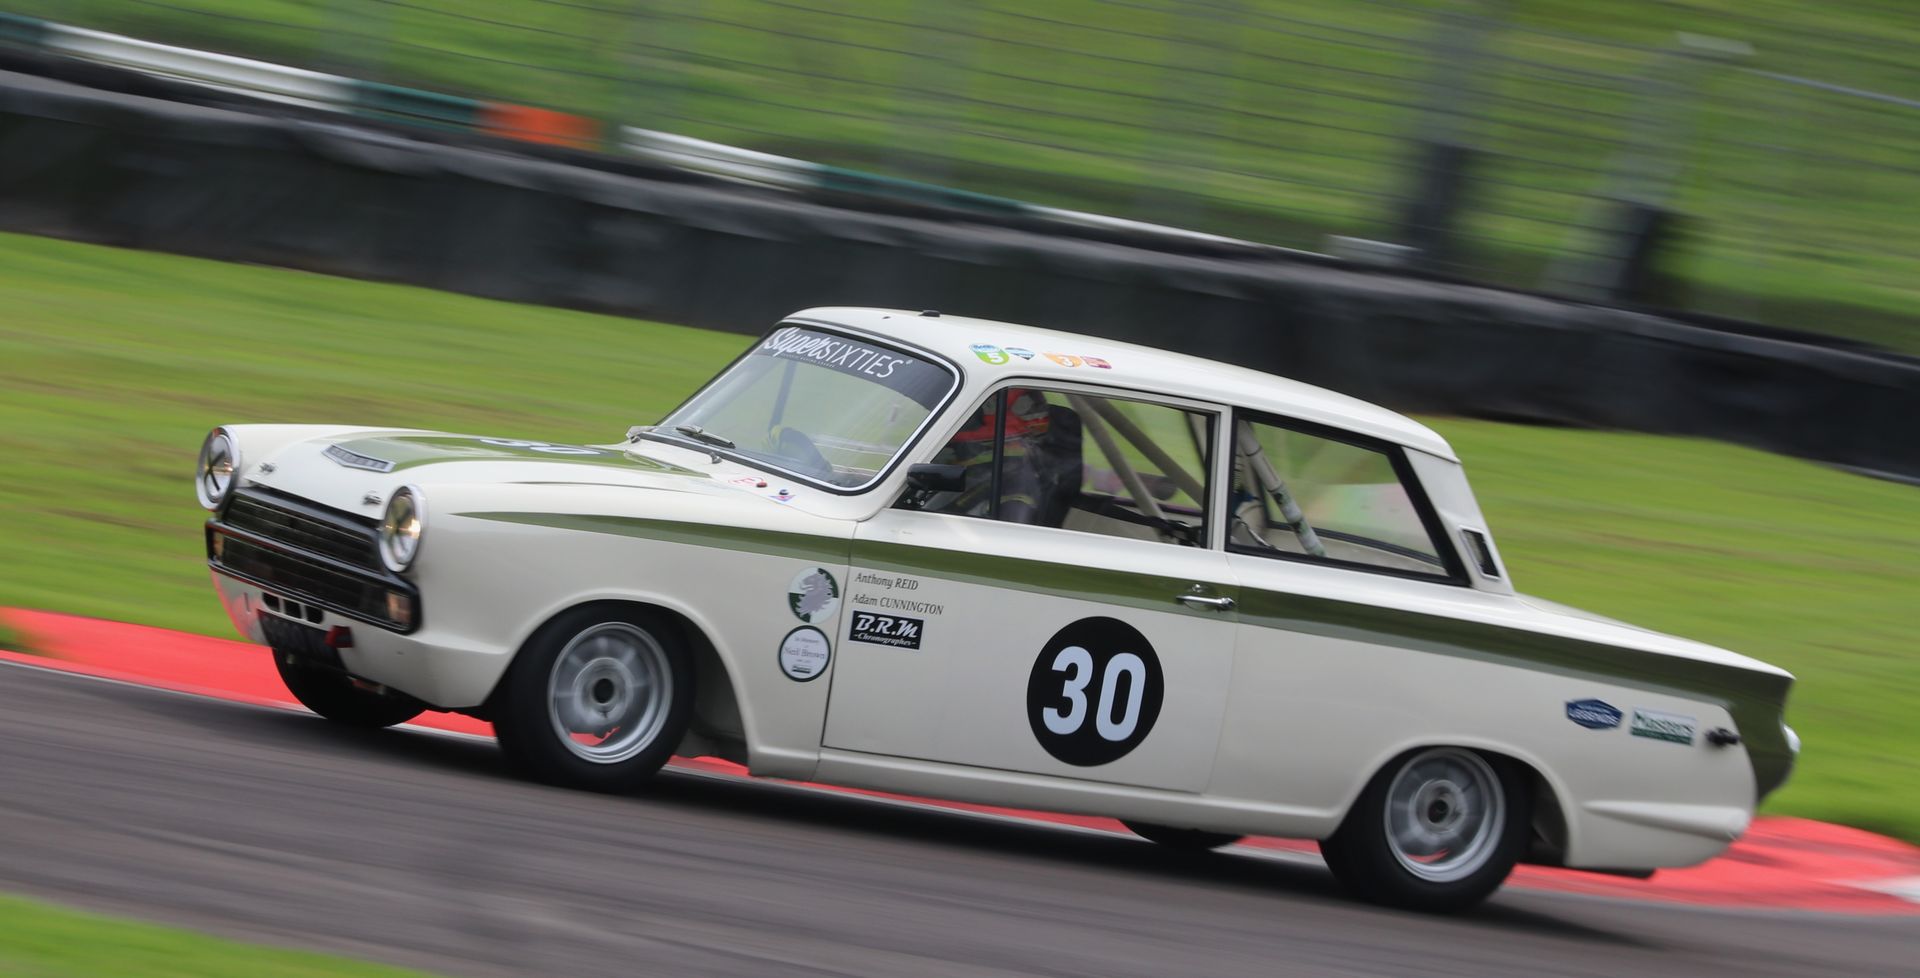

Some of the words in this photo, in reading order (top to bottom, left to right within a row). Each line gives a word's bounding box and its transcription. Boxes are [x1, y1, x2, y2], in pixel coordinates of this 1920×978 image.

[855, 572, 893, 589] Anthony
[895, 577, 919, 591] REID
[852, 593, 878, 606] Adam
[879, 597, 944, 615] CUNNINGTON
[1042, 645, 1147, 742] 30
